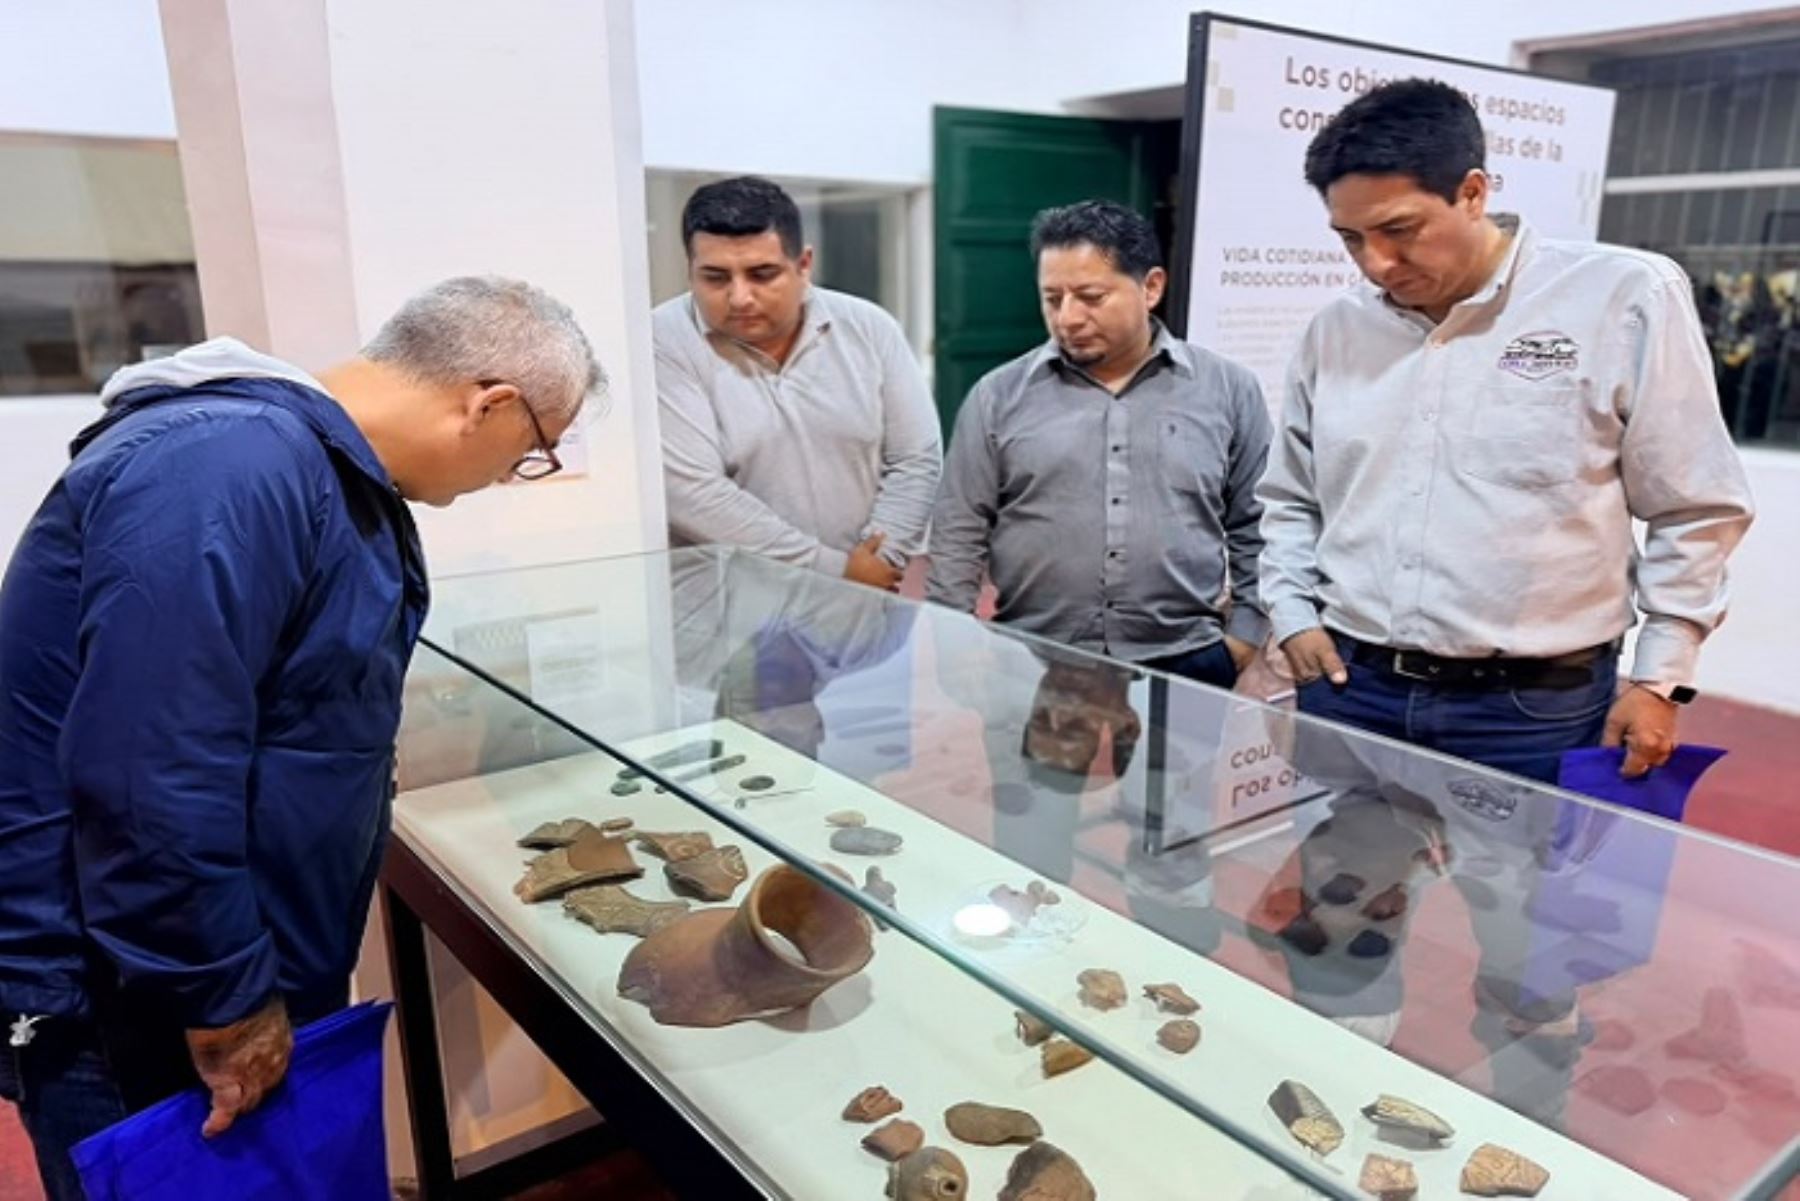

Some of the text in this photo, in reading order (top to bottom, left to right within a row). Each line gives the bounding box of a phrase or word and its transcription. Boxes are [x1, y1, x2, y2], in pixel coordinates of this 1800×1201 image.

[1286, 56, 1330, 88] Los
[1486, 96, 1564, 125] espacios
[1519, 134, 1542, 159] de
[1548, 138, 1562, 162] la
[1222, 248, 1346, 265] VIDA COTIDIANA
[1220, 269, 1320, 287] PRODUCCIÓN
[1325, 271, 1344, 287] EN
